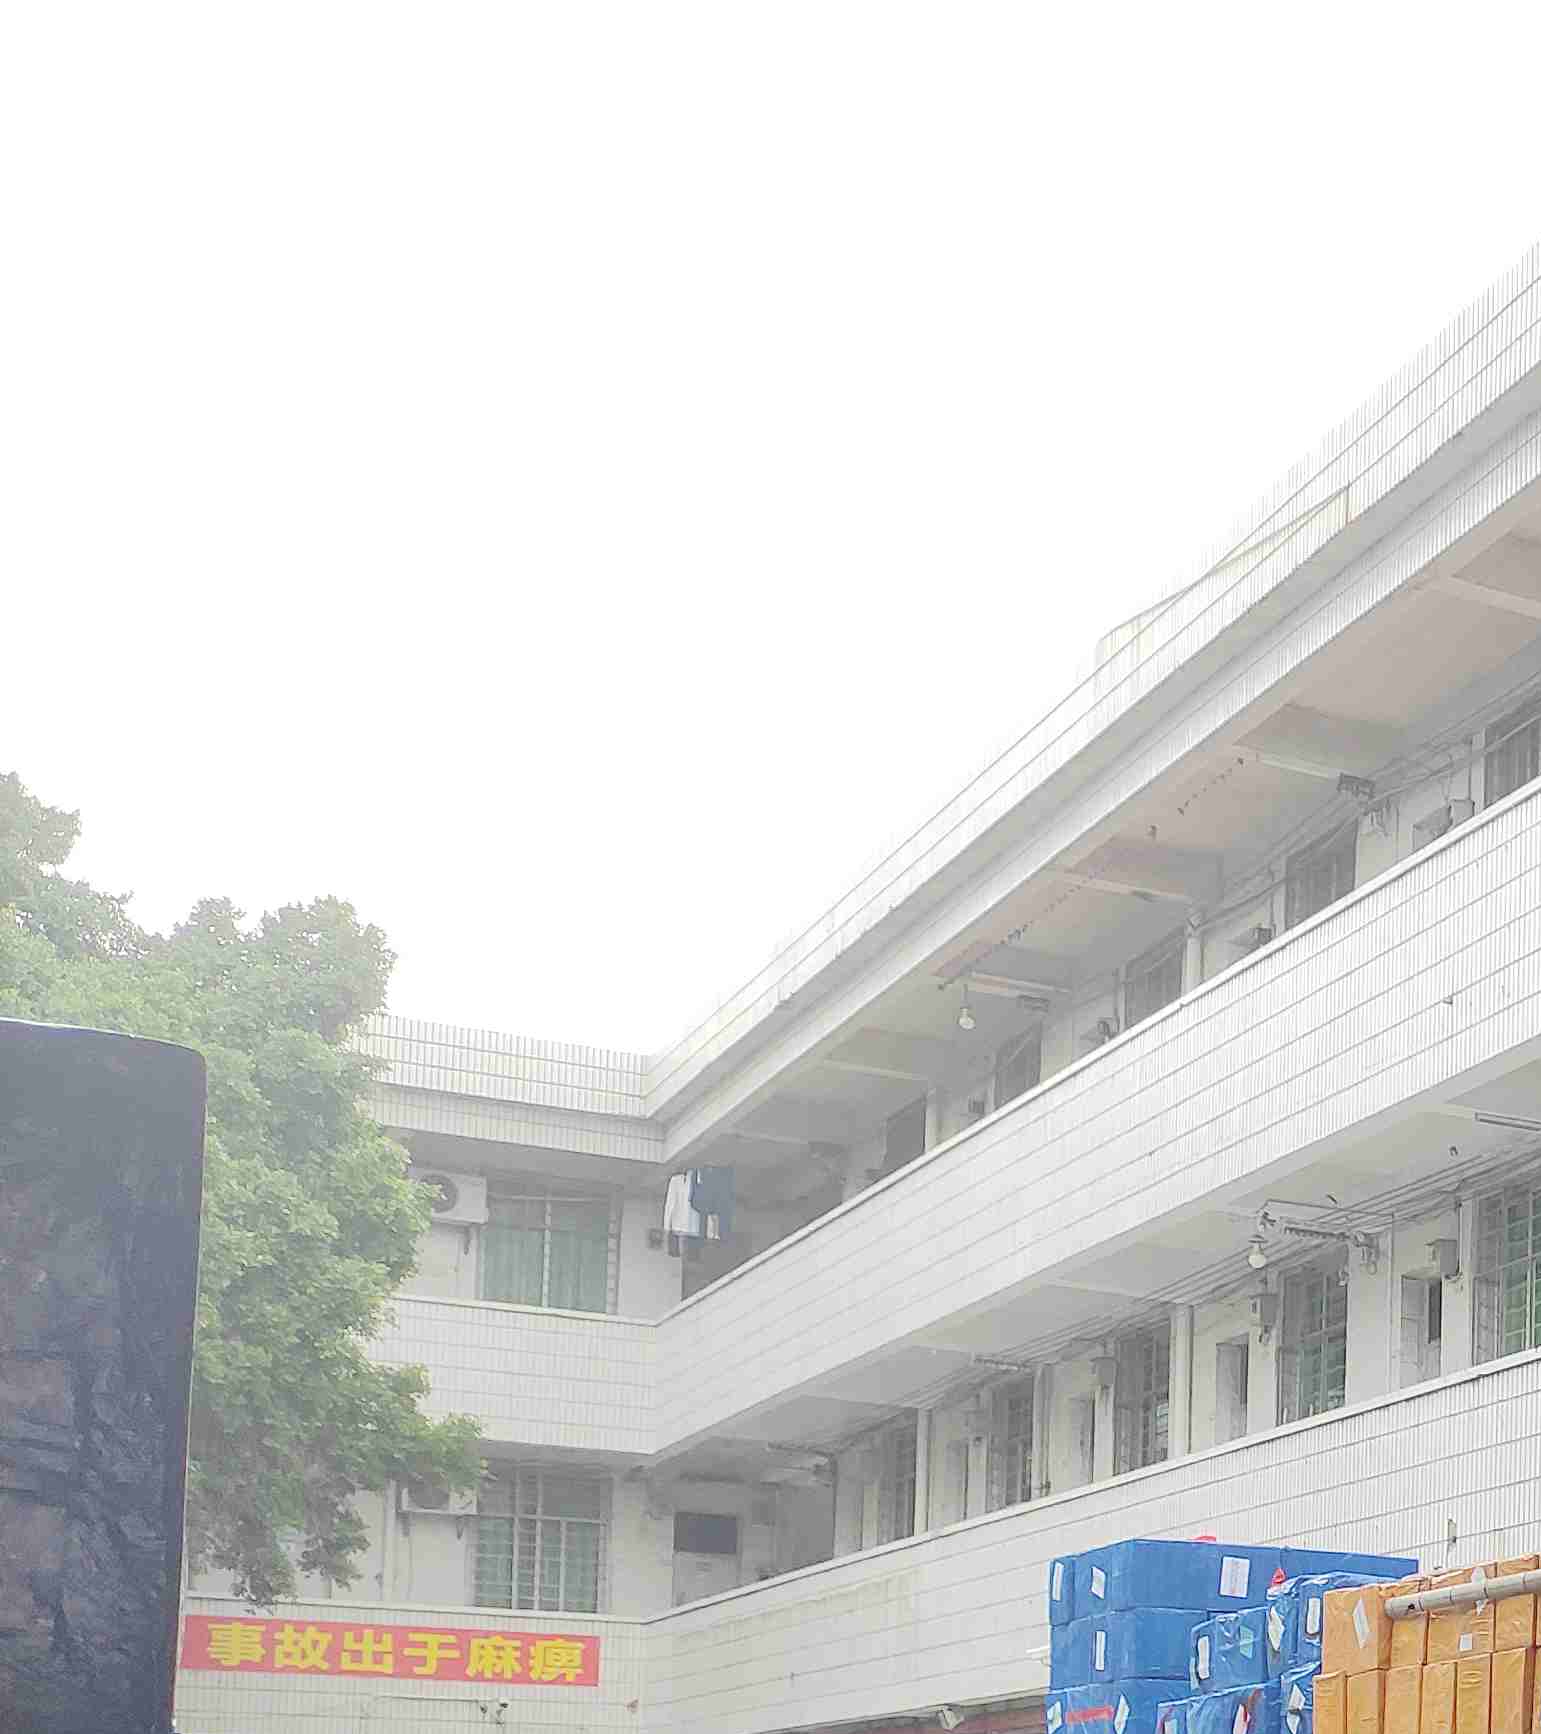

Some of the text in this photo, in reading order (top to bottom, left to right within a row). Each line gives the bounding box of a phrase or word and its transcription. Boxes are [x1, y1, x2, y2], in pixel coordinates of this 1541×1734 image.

[206, 1622, 586, 1681] 事故出于麻痹
